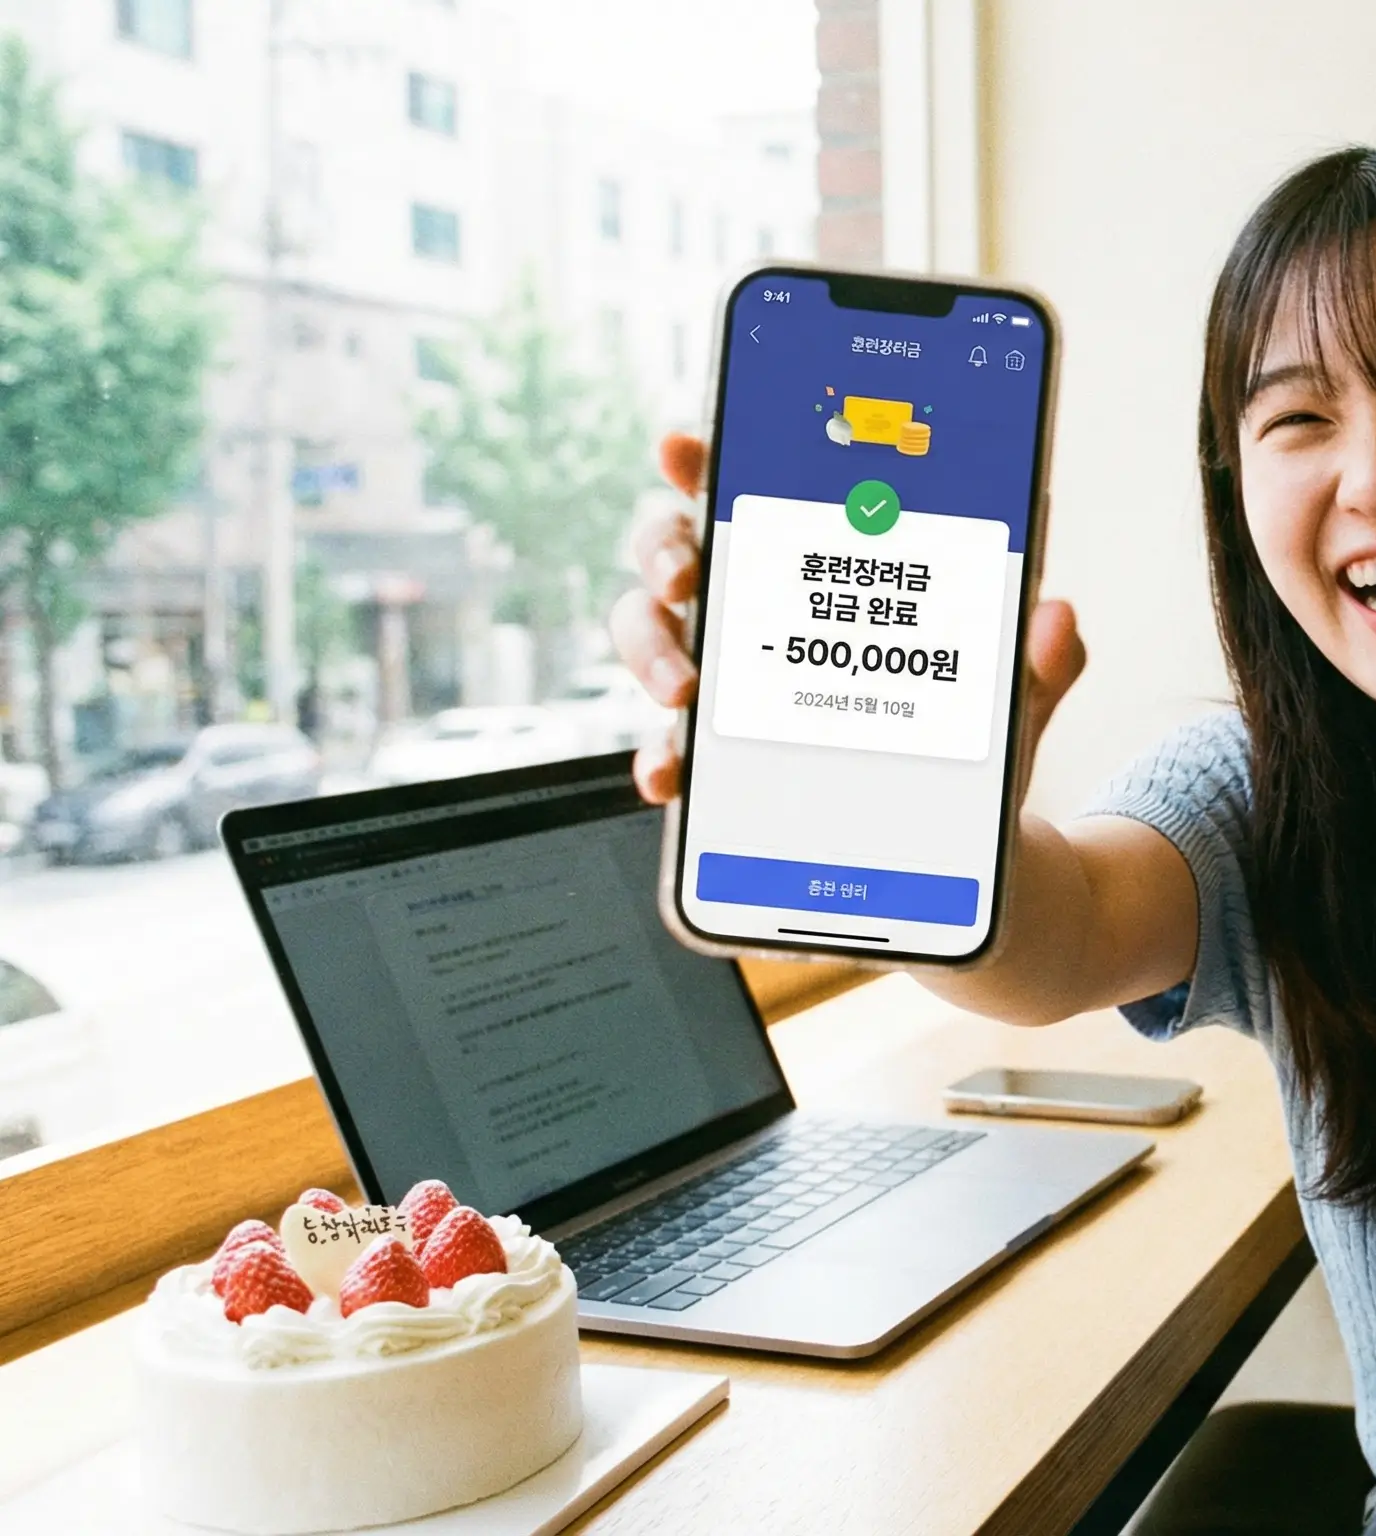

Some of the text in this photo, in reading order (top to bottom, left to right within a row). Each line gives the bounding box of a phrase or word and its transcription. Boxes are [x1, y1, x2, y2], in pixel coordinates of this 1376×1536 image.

[763, 289, 791, 304] 9:41
[800, 552, 932, 593] 훈련장려금
[809, 591, 918, 627] 입금 완료
[785, 636, 959, 683] 500,000원
[793, 690, 915, 719] 2024년 5월 10일
